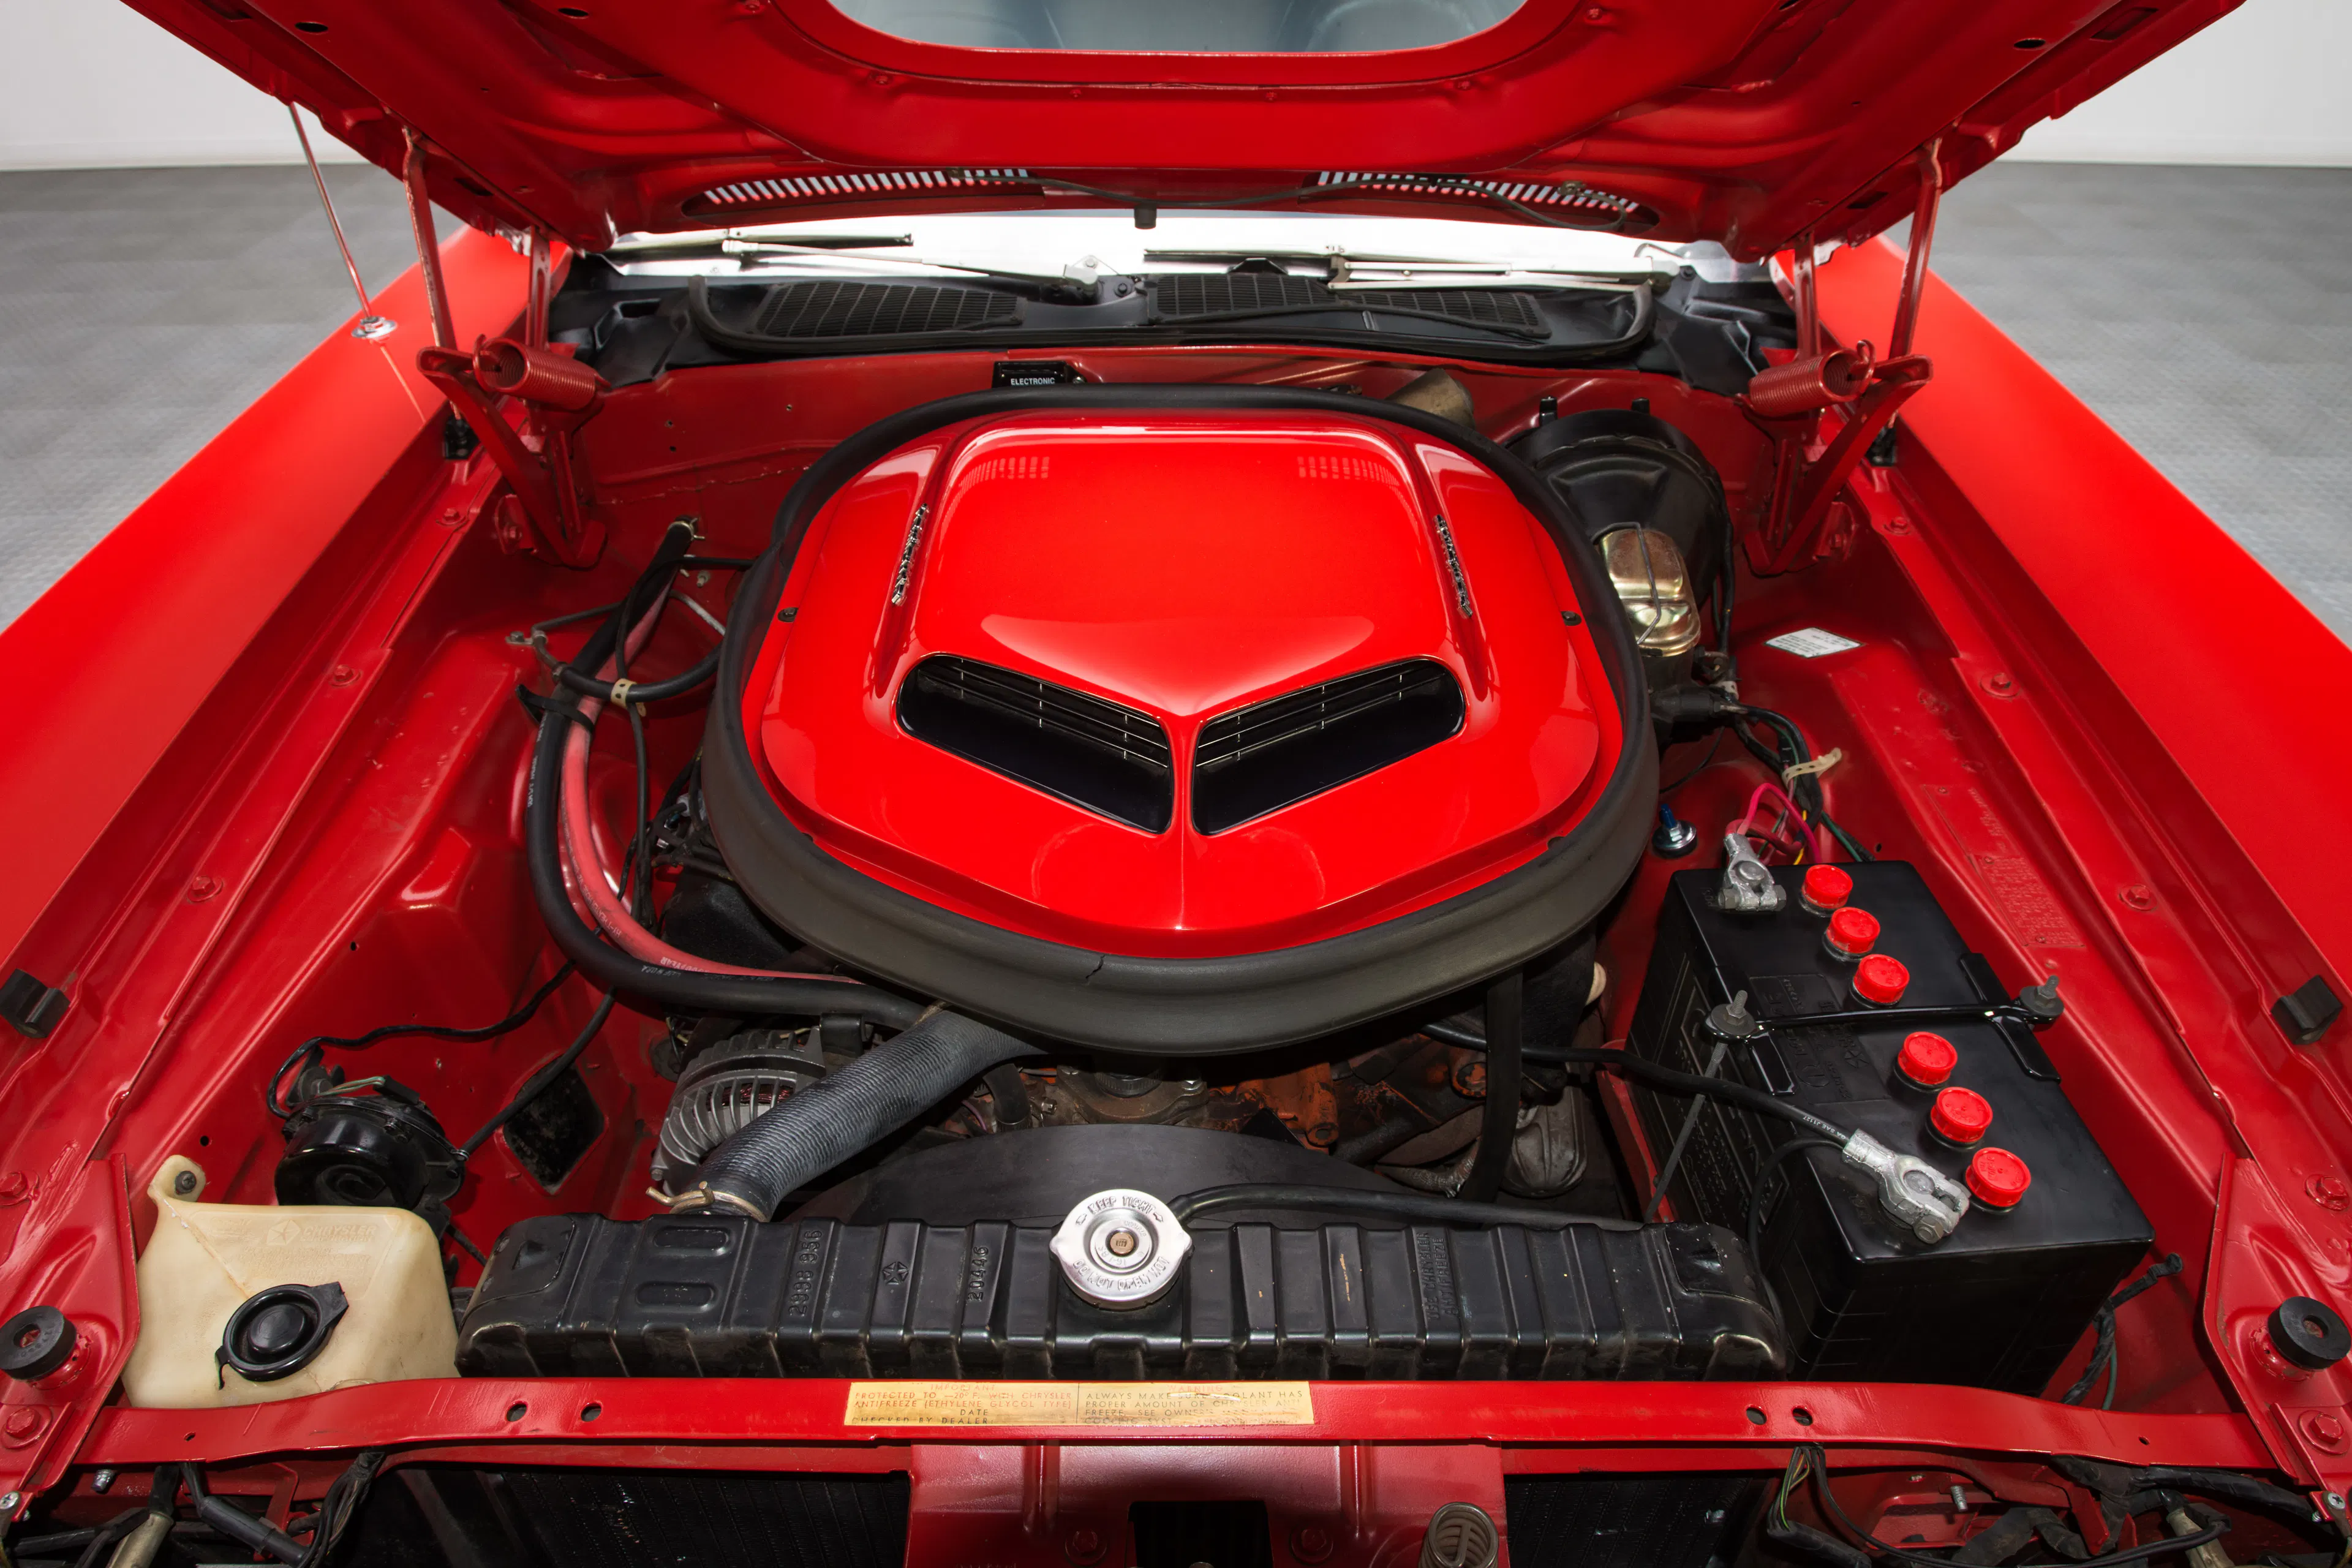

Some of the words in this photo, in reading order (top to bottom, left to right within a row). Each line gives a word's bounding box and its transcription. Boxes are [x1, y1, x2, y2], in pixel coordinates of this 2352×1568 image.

[1822, 1123, 1836, 1134] SAE
[1088, 1196, 1117, 1214] KEEP
[1122, 1195, 1156, 1214] TIGHT
[1416, 1232, 1435, 1290] CHRYSLER
[1072, 1259, 1090, 1275] DO
[1087, 1272, 1114, 1289] NOT
[1118, 1272, 1152, 1291] OPEN
[1432, 1237, 1458, 1315] ANTIFREEZE
[1425, 1296, 1439, 1320] USE
[1043, 1400, 1071, 1409] TYPE)
